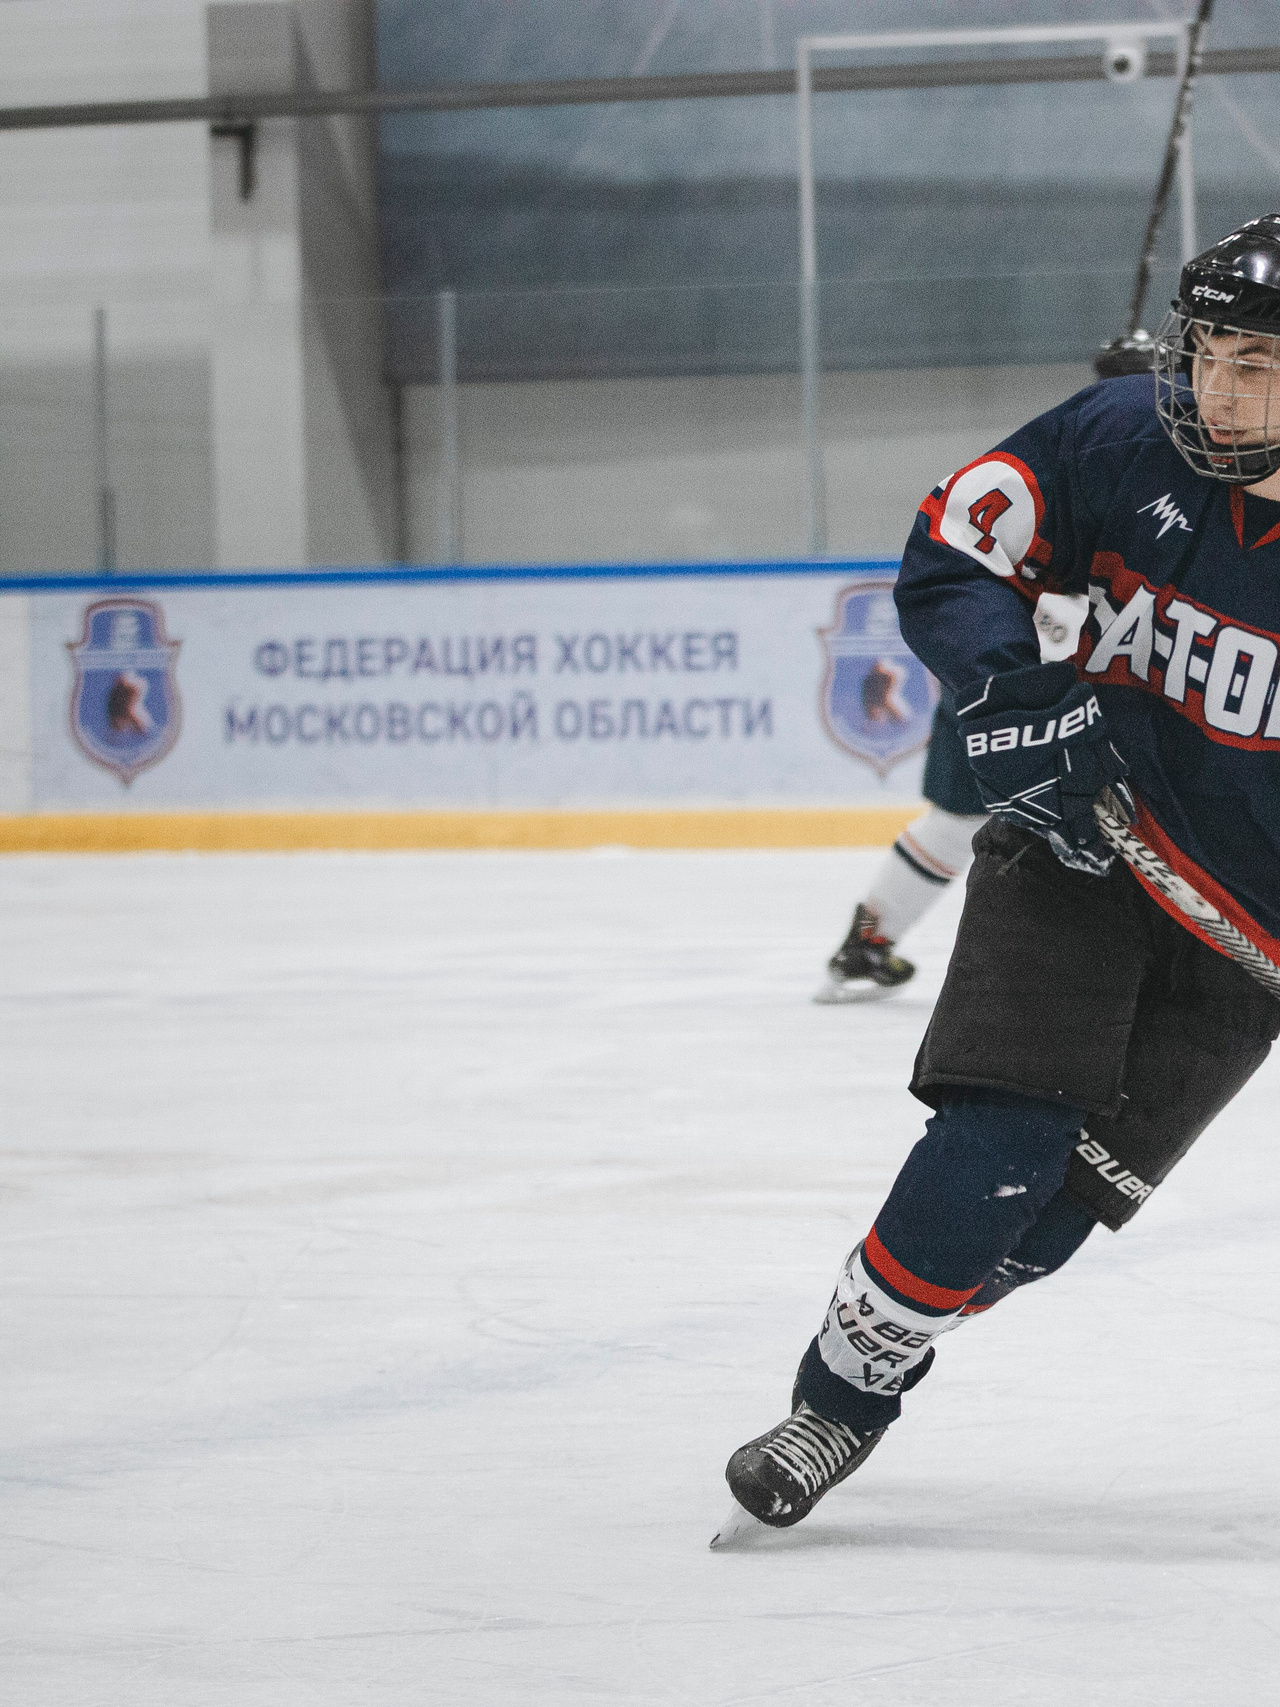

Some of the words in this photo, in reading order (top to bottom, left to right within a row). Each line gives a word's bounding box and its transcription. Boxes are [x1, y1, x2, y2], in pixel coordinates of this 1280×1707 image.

[1191, 285, 1235, 304] CCM
[253, 632, 537, 684] ФЕДЕРАЦИЯ
[553, 630, 739, 674] ХОККЕЯ
[224, 690, 539, 744] МОСКОВСКОЙ
[553, 698, 774, 740] ОБЛАСТИ
[1101, 815, 1178, 877] OYUZ
